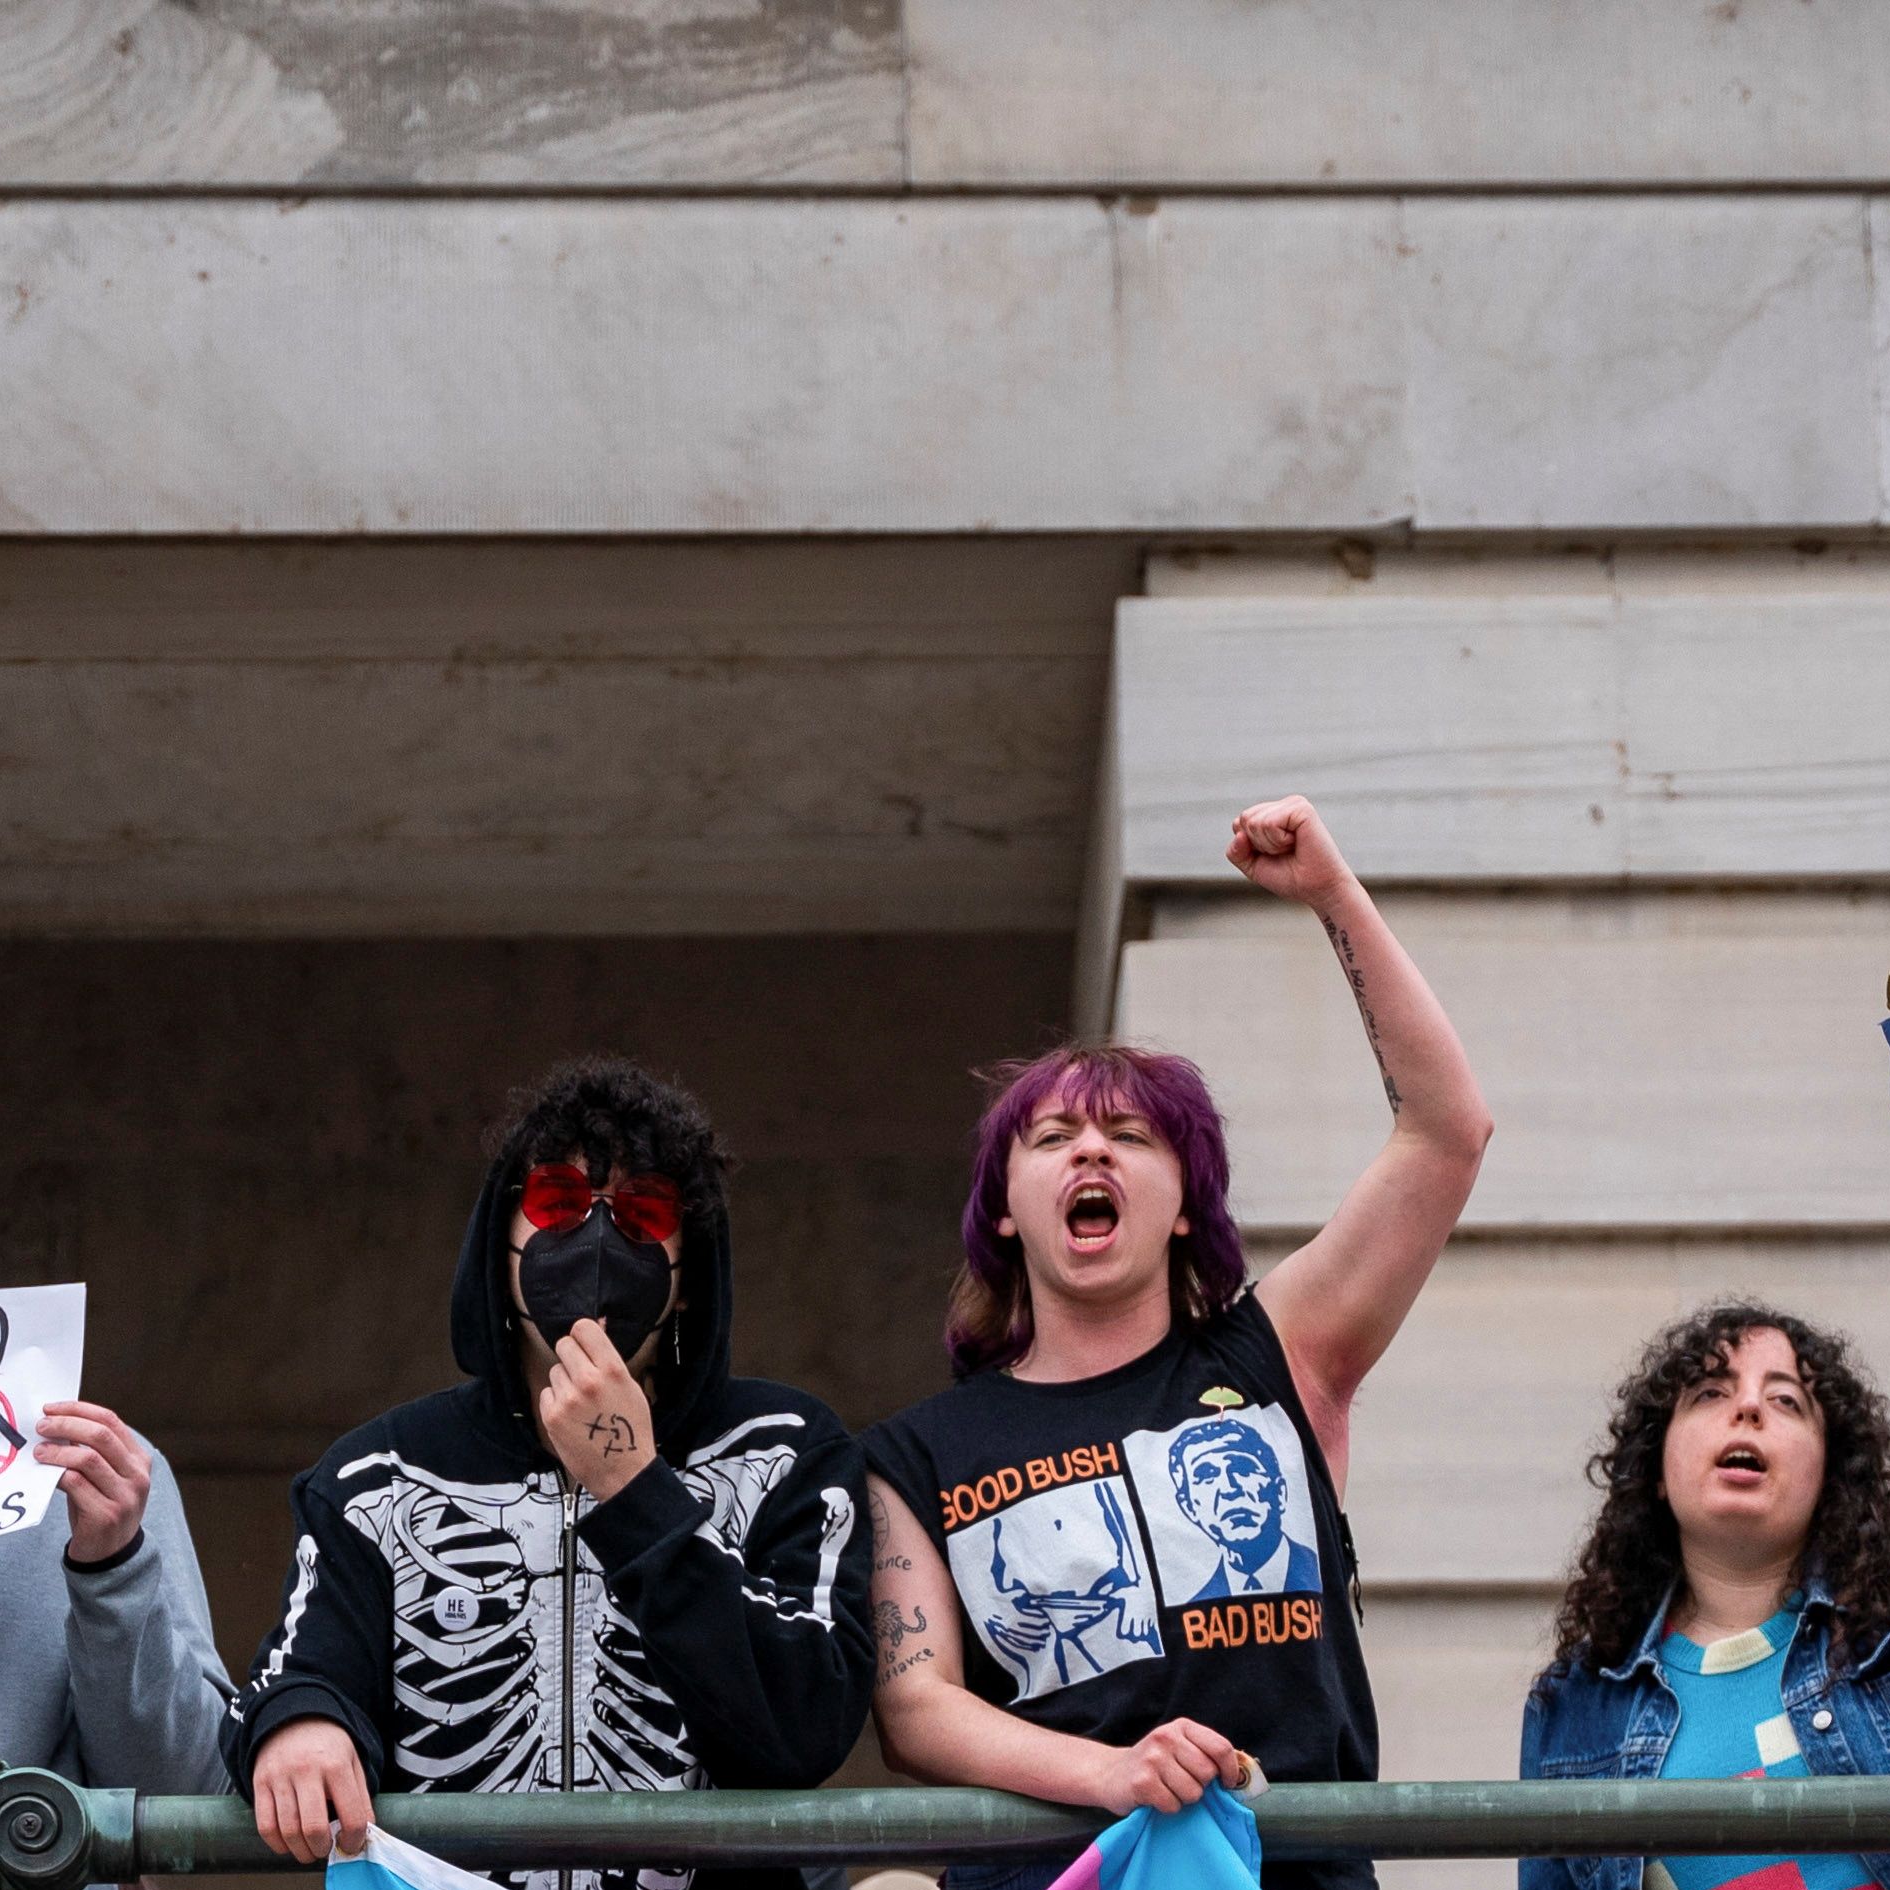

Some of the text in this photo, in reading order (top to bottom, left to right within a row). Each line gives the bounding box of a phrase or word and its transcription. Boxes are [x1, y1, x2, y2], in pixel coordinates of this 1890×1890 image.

[939, 1442, 1120, 1529] GOOD BUSH
[448, 1599, 464, 1612] HE
[1182, 1600, 1323, 1649] BAD BUSH
